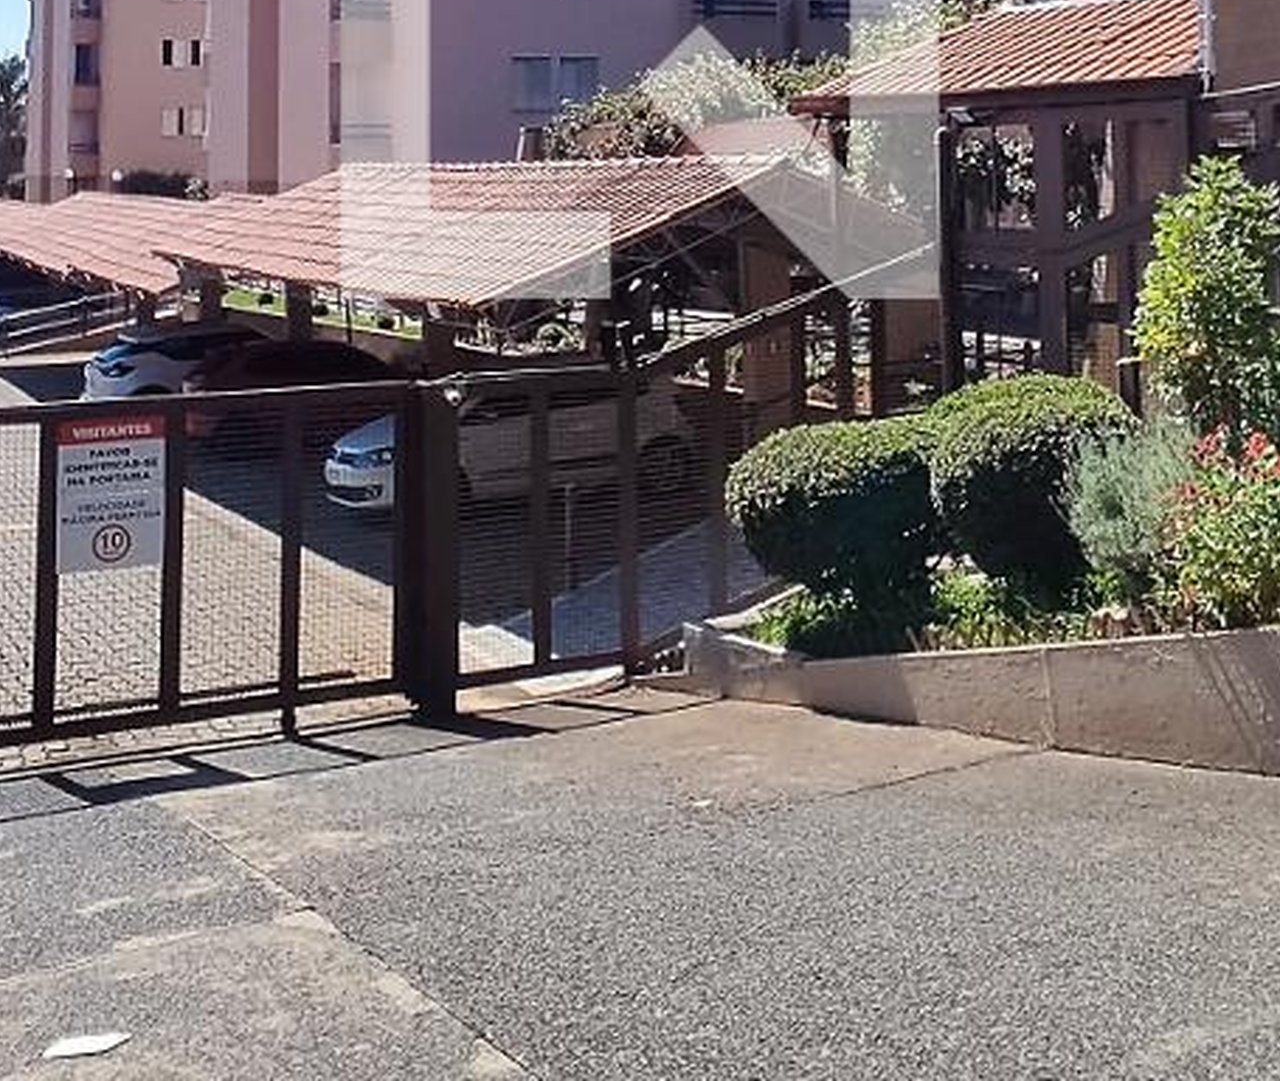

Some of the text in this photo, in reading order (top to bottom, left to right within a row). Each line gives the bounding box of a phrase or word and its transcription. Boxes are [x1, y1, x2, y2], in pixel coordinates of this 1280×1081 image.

[72, 423, 152, 439] VISITANTES
[89, 447, 130, 459] FAVOR
[67, 471, 151, 487] NA PORTARIA
[102, 531, 124, 550] 10
